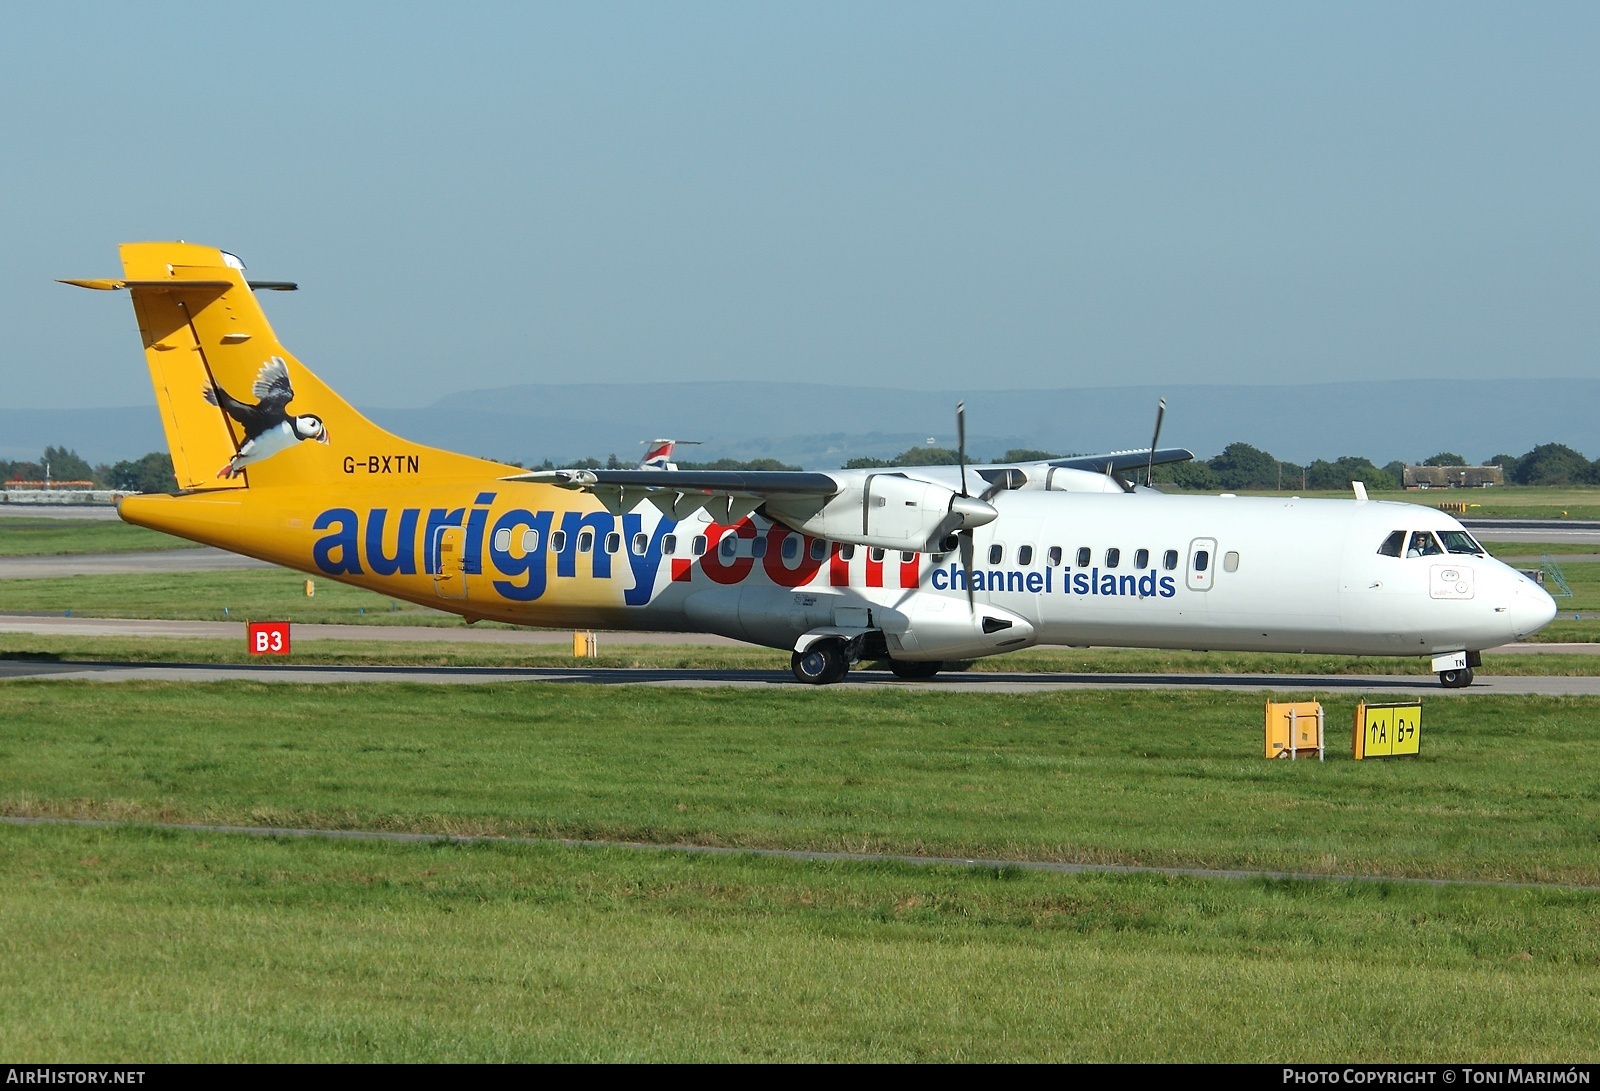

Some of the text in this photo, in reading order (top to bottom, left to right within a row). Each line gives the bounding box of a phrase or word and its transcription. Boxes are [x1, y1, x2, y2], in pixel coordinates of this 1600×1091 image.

[343, 456, 419, 474] G-BXTN
[931, 563, 1176, 598] channel islands
[256, 631, 282, 652] B3
[1454, 659, 1465, 667] TN
[1379, 719, 1405, 744] A B
